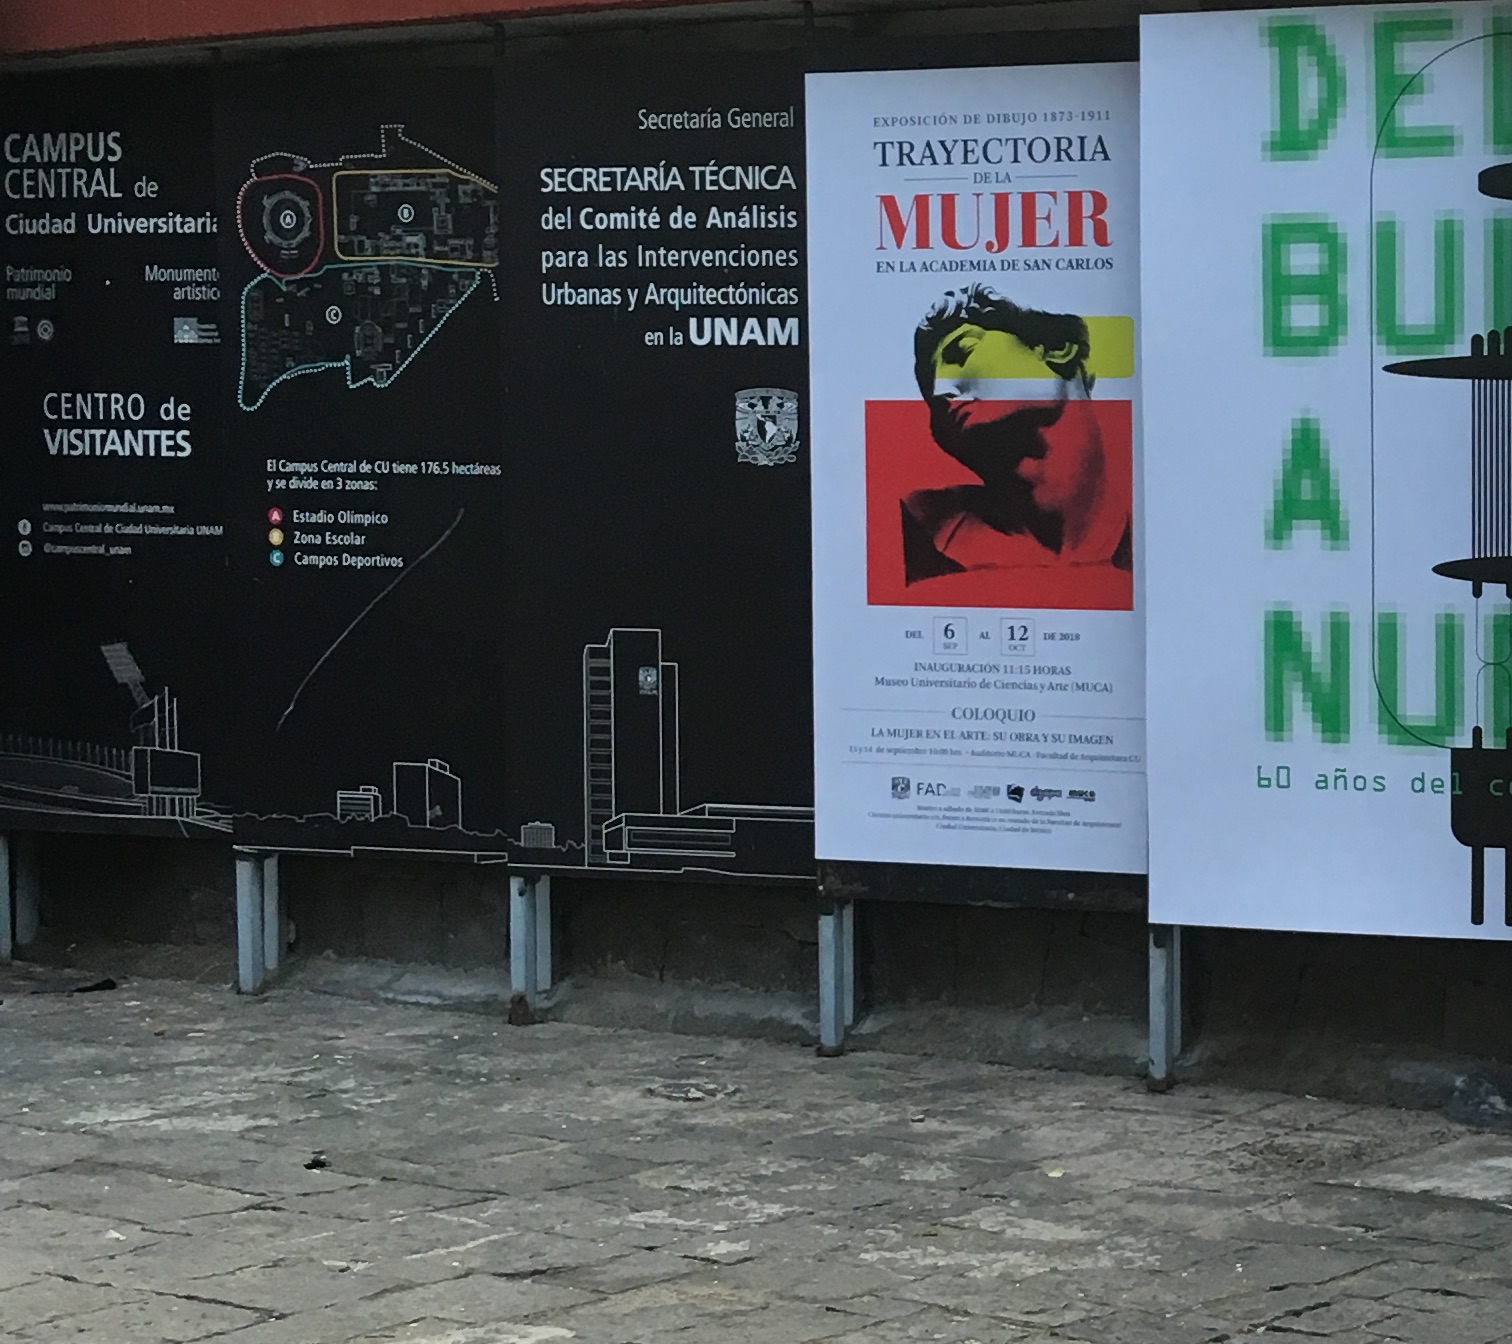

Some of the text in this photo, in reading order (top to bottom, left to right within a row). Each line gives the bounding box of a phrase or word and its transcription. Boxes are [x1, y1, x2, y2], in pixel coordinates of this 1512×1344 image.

[638, 106, 795, 130] Secretaría General
[873, 110, 1111, 128] EXPOSICIÓN DE DIBUJO 1873-1911
[4, 131, 122, 163] CAMPUS
[873, 134, 1111, 167] TRAYECTORIA
[4, 167, 158, 199] CENTRAL de
[540, 160, 797, 193] SECRETARÍA TÉCNICA
[973, 171, 1012, 185] DE LA
[6, 212, 76, 235] Ciudad
[541, 205, 798, 231] del Comité de Análisis
[875, 189, 1113, 254] MUJER
[541, 244, 799, 274] para las Intervenciones
[876, 257, 1114, 274] EN LA ACADEMIA DE SAN CARLOS
[6, 266, 72, 283] Patrimonio
[6, 284, 56, 301] mundial
[542, 281, 799, 311] Urbanas y Arquitectónicas
[644, 317, 799, 346] en la UNAM
[44, 393, 192, 422] CENTRO de
[44, 428, 192, 458] VISITANTES
[267, 459, 502, 476] El Campus Central de CU tiene 176.5 hectáreas
[266, 476, 378, 492] y se divide en 3 zonas:
[1263, 404, 1351, 552] A
[293, 509, 335, 524] Estadio
[338, 510, 389, 526] Olímpico
[294, 531, 321, 545] Zona
[325, 532, 366, 546] Escolar
[294, 552, 338, 567] Campos
[342, 553, 404, 568] Deportivos
[905, 630, 924, 640] DEL
[943, 623, 955, 641] 6
[979, 631, 991, 641] AL
[1007, 625, 1029, 642] 12
[1043, 632, 1057, 642] DE
[914, 660, 1001, 675] INAUGURACIÓN
[1033, 665, 1072, 677] HORAS
[874, 676, 909, 688] Museo
[911, 677, 977, 690] Universitario
[979, 677, 992, 690] de
[994, 678, 1038, 691] Ciencias
[951, 707, 1036, 724] COLOQUIO
[871, 727, 885, 738] LA
[887, 728, 924, 741] MUJER
[926, 729, 942, 740] EN
[943, 729, 957, 740] EL
[993, 731, 1008, 742] SU
[1009, 731, 1042, 744] OBRA
[1042, 732, 1050, 744] Y
[1051, 733, 1066, 744] SU
[1068, 734, 1114, 746] IMAGEN
[1256, 765, 1292, 791] 60
[1314, 767, 1388, 794] años
[1410, 772, 1464, 796] del
